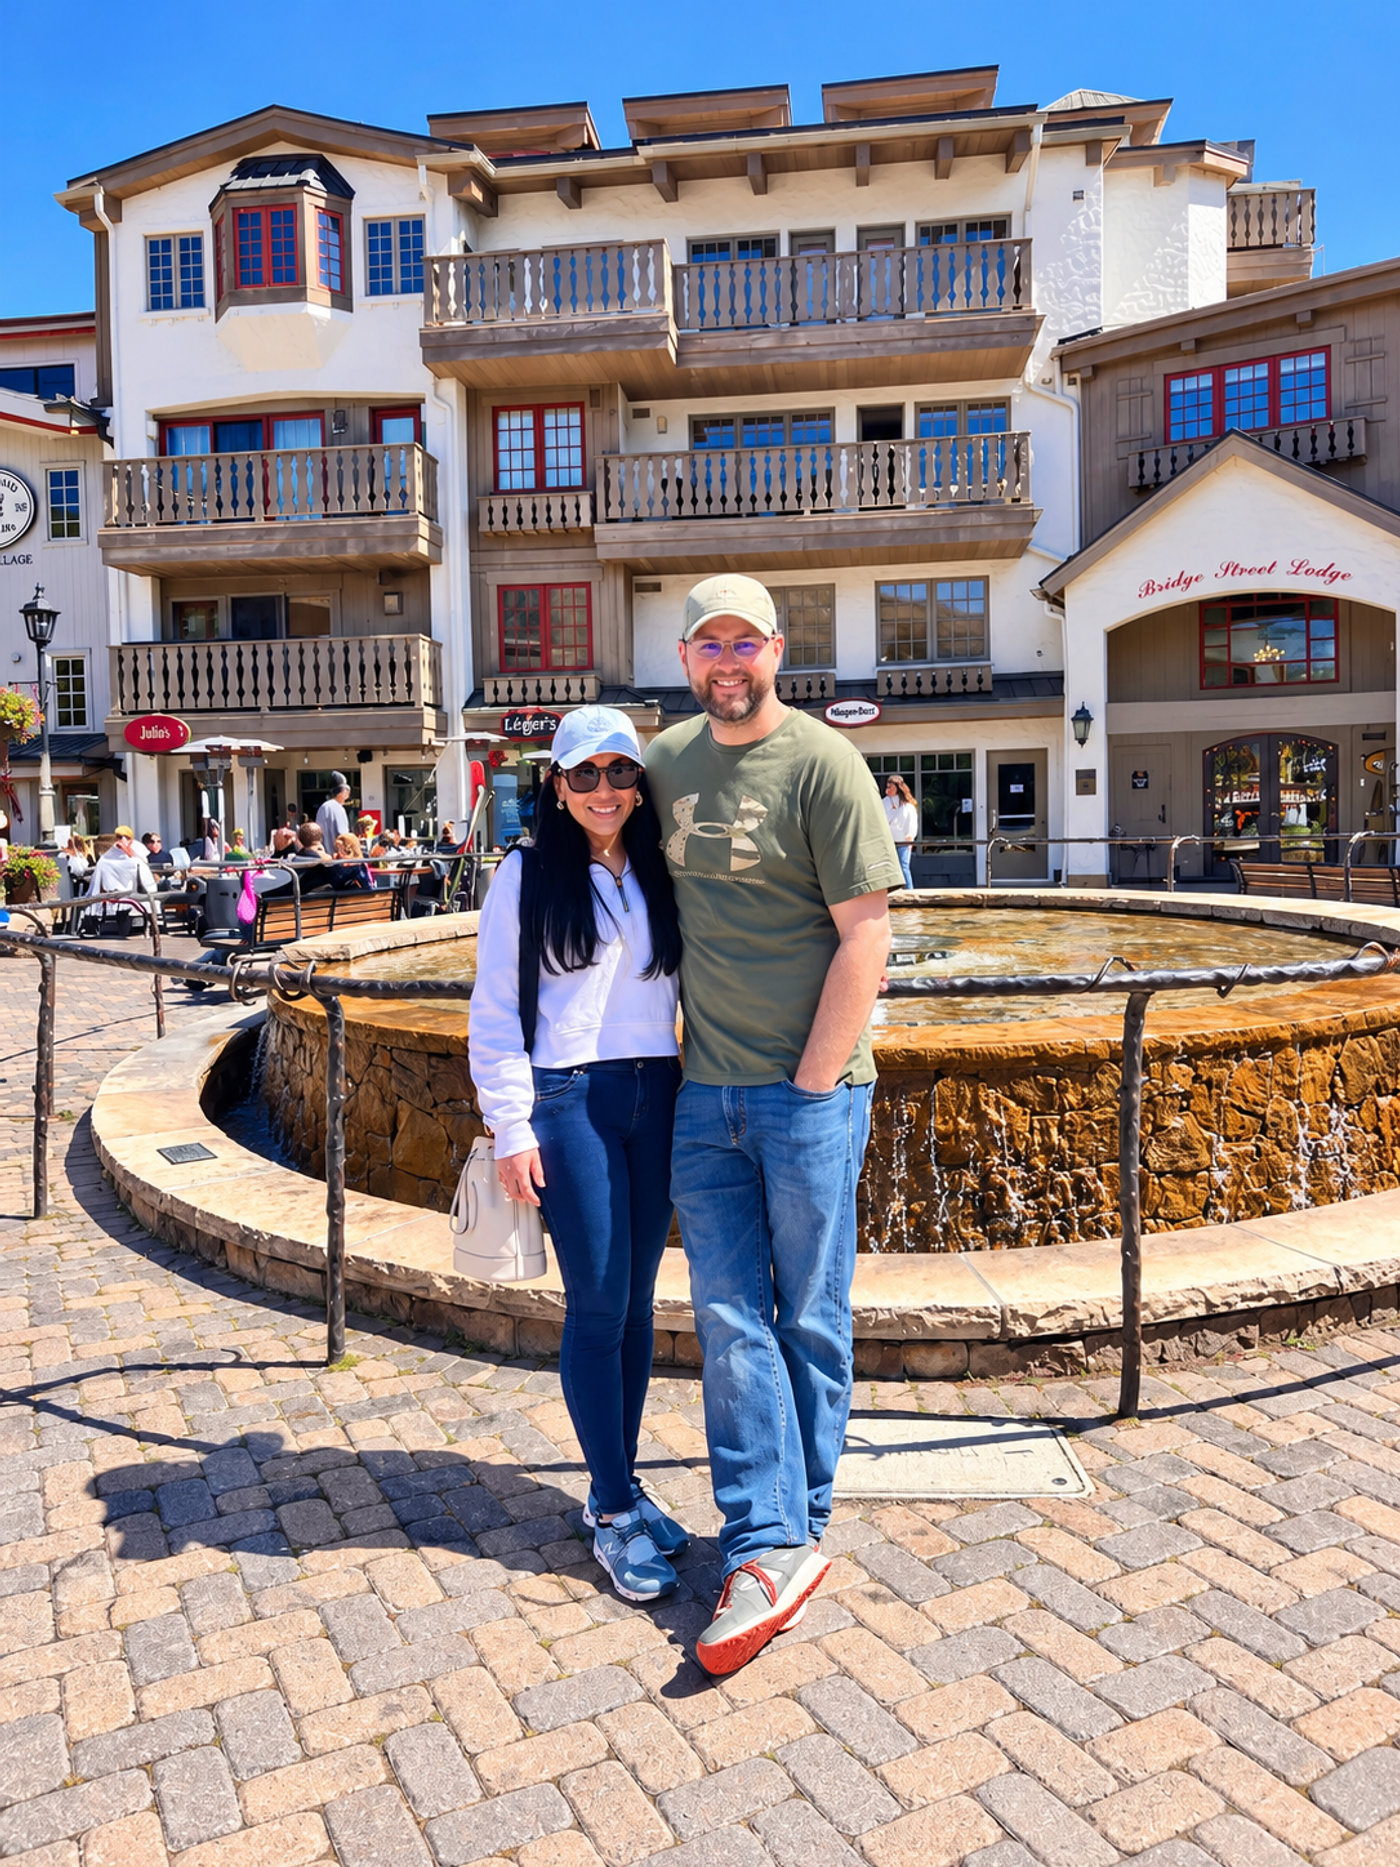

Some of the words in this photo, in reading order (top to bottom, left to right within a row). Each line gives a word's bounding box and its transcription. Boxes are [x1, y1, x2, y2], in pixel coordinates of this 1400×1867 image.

[0, 554, 33, 565] LAGE
[1138, 570, 1205, 599] Bridge
[1214, 560, 1277, 579] Street
[1286, 558, 1353, 586] Lodge
